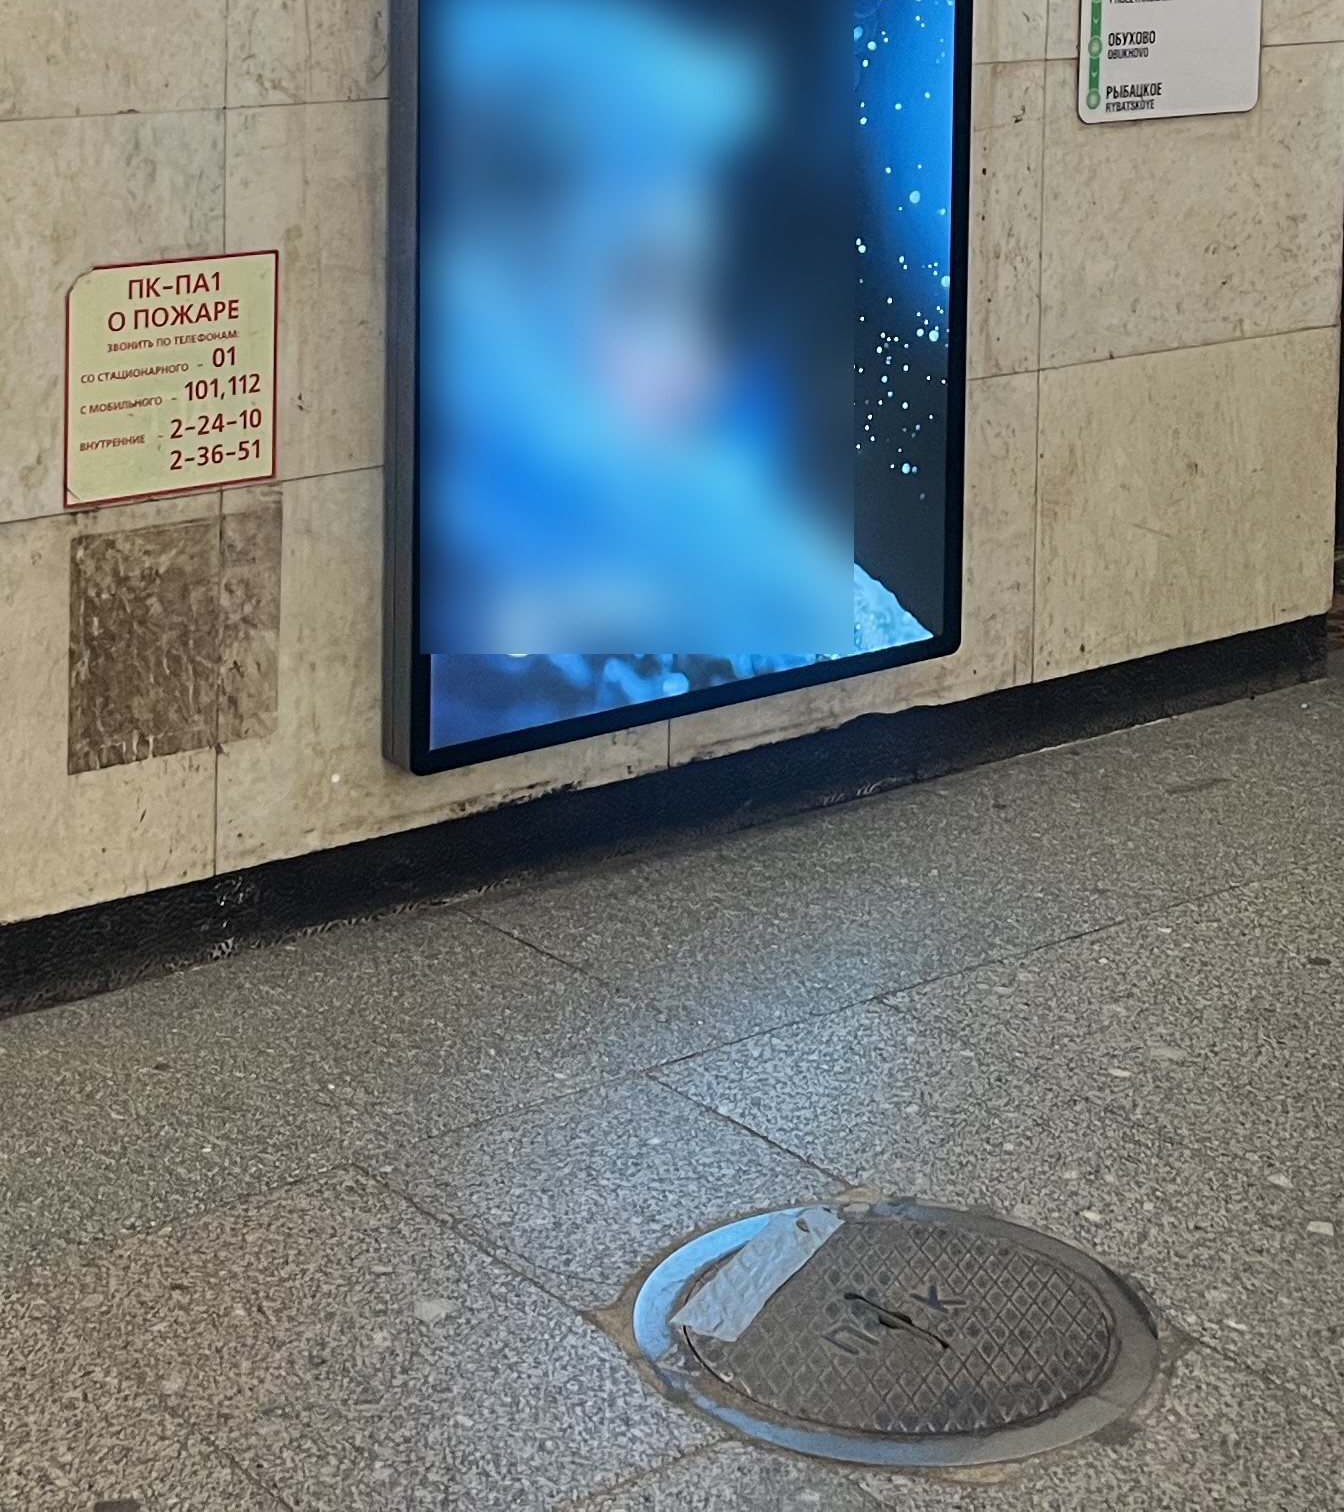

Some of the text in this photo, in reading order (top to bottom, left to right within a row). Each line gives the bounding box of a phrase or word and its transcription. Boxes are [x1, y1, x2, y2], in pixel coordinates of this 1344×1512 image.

[1107, 47, 1149, 59] OBUKHOVO
[1108, 30, 1156, 47] ОБУХОВО
[1105, 81, 1163, 99] РЫБАЦКОЕ
[1105, 99, 1155, 113] RYBATSKOYE
[127, 271, 222, 300] ПК-ПА1
[107, 299, 240, 332] О ПОЖАРЕ
[107, 339, 154, 353] ЗВОНИТЬ
[156, 338, 172, 347] ПО
[80, 374, 95, 384] СО
[97, 363, 189, 383] СТАЦИОНАРНОГО
[212, 346, 236, 368] 01
[80, 405, 87, 415] С
[89, 396, 163, 414] МОБИЛЬНОГО
[184, 373, 261, 401] 101,112
[79, 434, 146, 452] ВНУТРЕННИЕ
[170, 408, 262, 439] 2-24-10
[169, 439, 261, 471] 2-36-51
